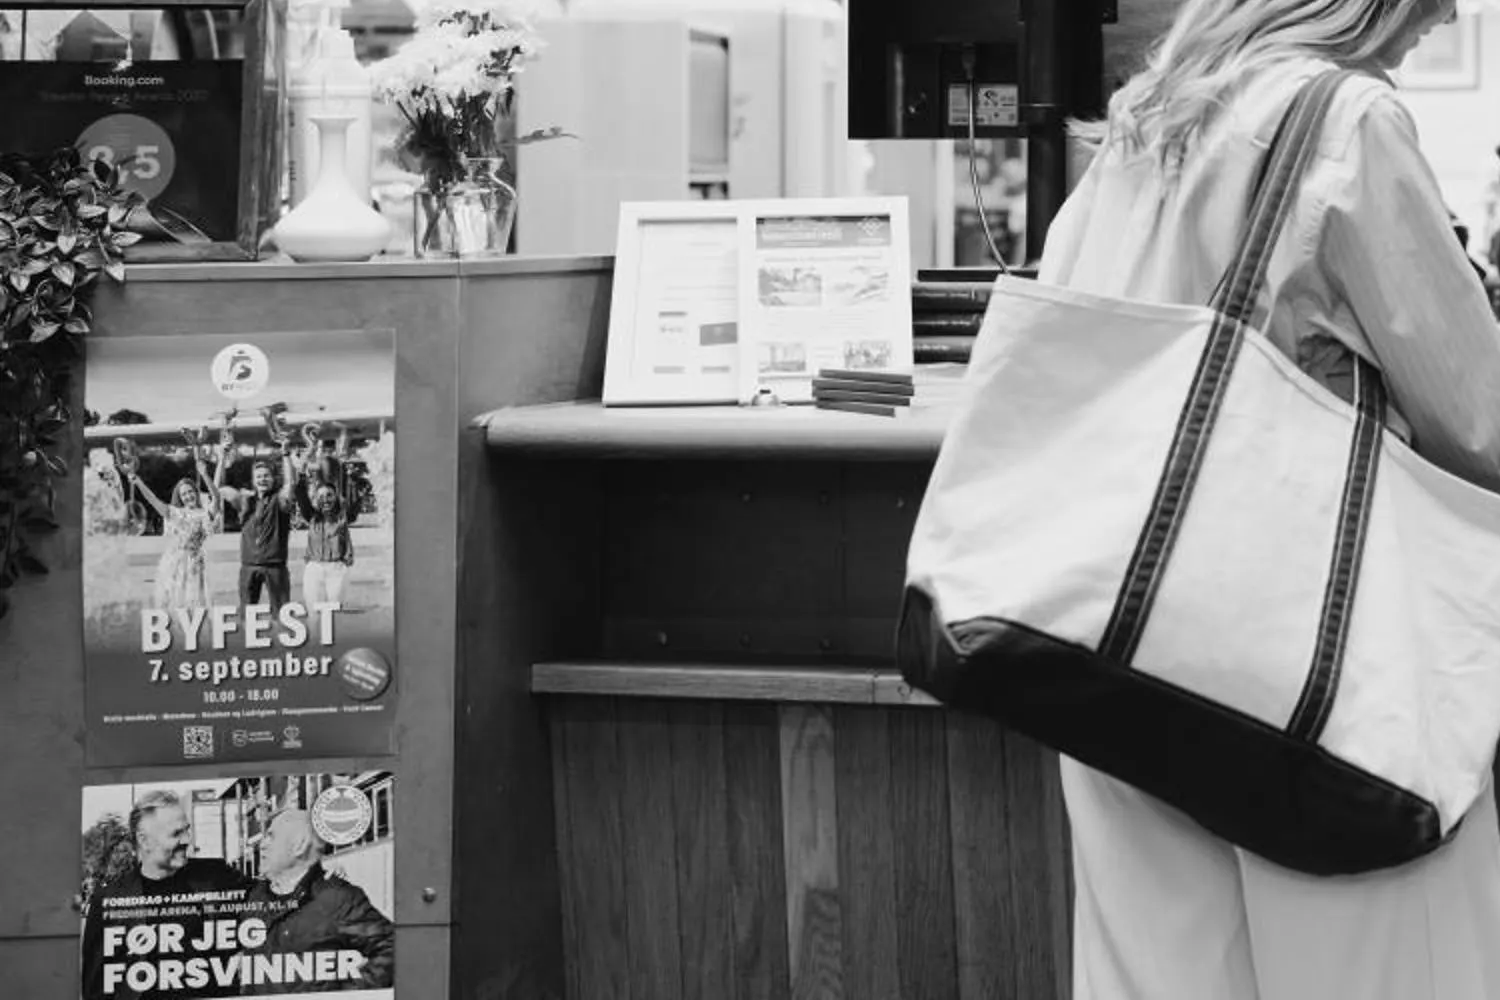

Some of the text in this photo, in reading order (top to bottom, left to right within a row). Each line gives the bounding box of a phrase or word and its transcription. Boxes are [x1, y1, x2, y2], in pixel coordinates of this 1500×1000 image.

[84, 74, 164, 87] Booking.com
[141, 601, 341, 652] BYFEST
[149, 659, 169, 681] 7.
[178, 652, 333, 685] september
[203, 690, 236, 703] 10.00
[102, 895, 162, 907] FOREDRAG
[219, 901, 268, 913] AUGUST,
[103, 917, 267, 957] FØR JEG
[103, 949, 367, 994] FORSVINNER
